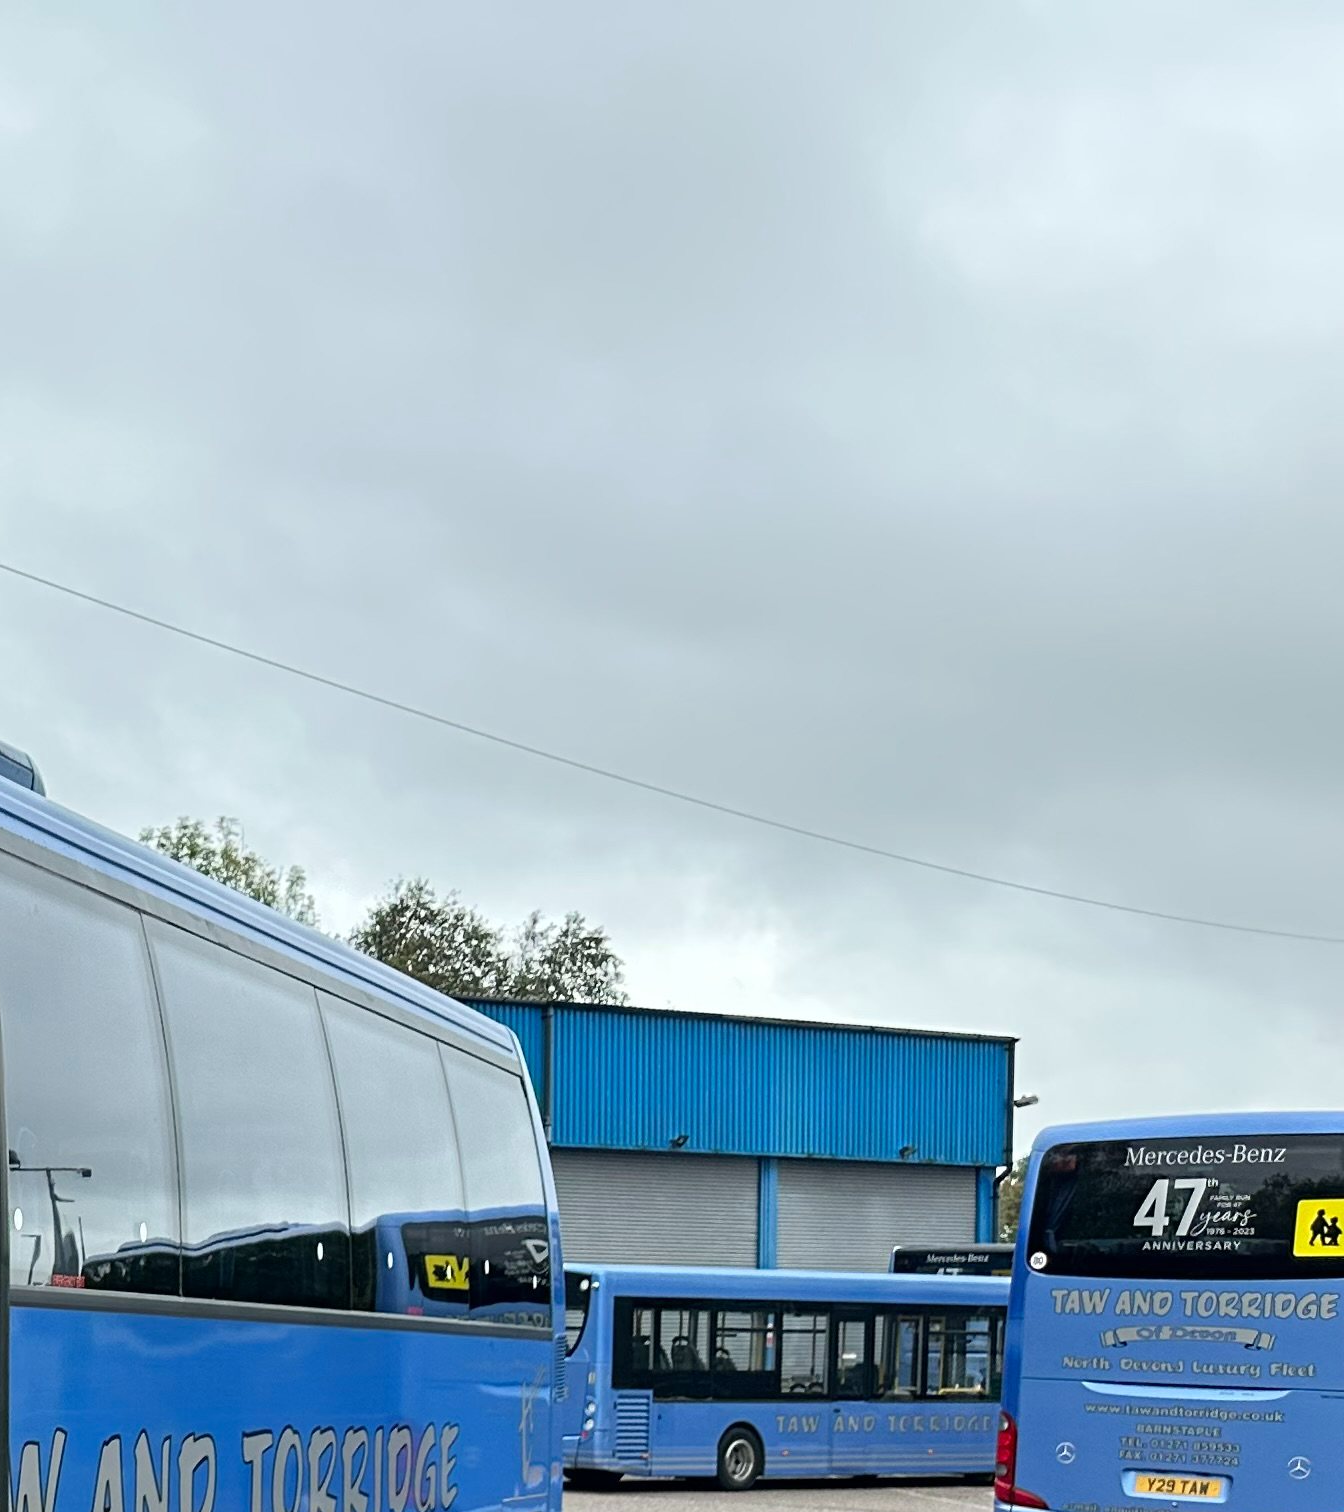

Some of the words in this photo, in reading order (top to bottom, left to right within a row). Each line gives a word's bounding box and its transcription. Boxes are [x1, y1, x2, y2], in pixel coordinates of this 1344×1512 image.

[1124, 1144, 1287, 1167] Mercedes-Benz
[1190, 1208, 1258, 1237] years
[1232, 1227, 1255, 1235] 2023
[1142, 1240, 1241, 1251] ANNIVERSARY
[926, 1253, 990, 1264] Mercedes-Benz
[1051, 1287, 1111, 1316] TAW
[1114, 1288, 1174, 1318] AND
[1179, 1289, 1340, 1322] TORRIDGE
[1135, 1325, 1163, 1341] Of
[1170, 1327, 1238, 1342] Devon
[1062, 1355, 1111, 1371] North
[1192, 1360, 1261, 1379] Luxury
[1269, 1362, 1317, 1378] Fleet
[1084, 1402, 1285, 1423] www.tawandtorridge.co.uk
[776, 1414, 820, 1433] TAW
[833, 1414, 875, 1433] AND
[1136, 1423, 1222, 1438] BARNSTAPLE
[1150, 1438, 1188, 1451] 01271
[1150, 1452, 1187, 1465] 01271
[1147, 1477, 1176, 1493] Y29
[1180, 1480, 1210, 1497] TAW
